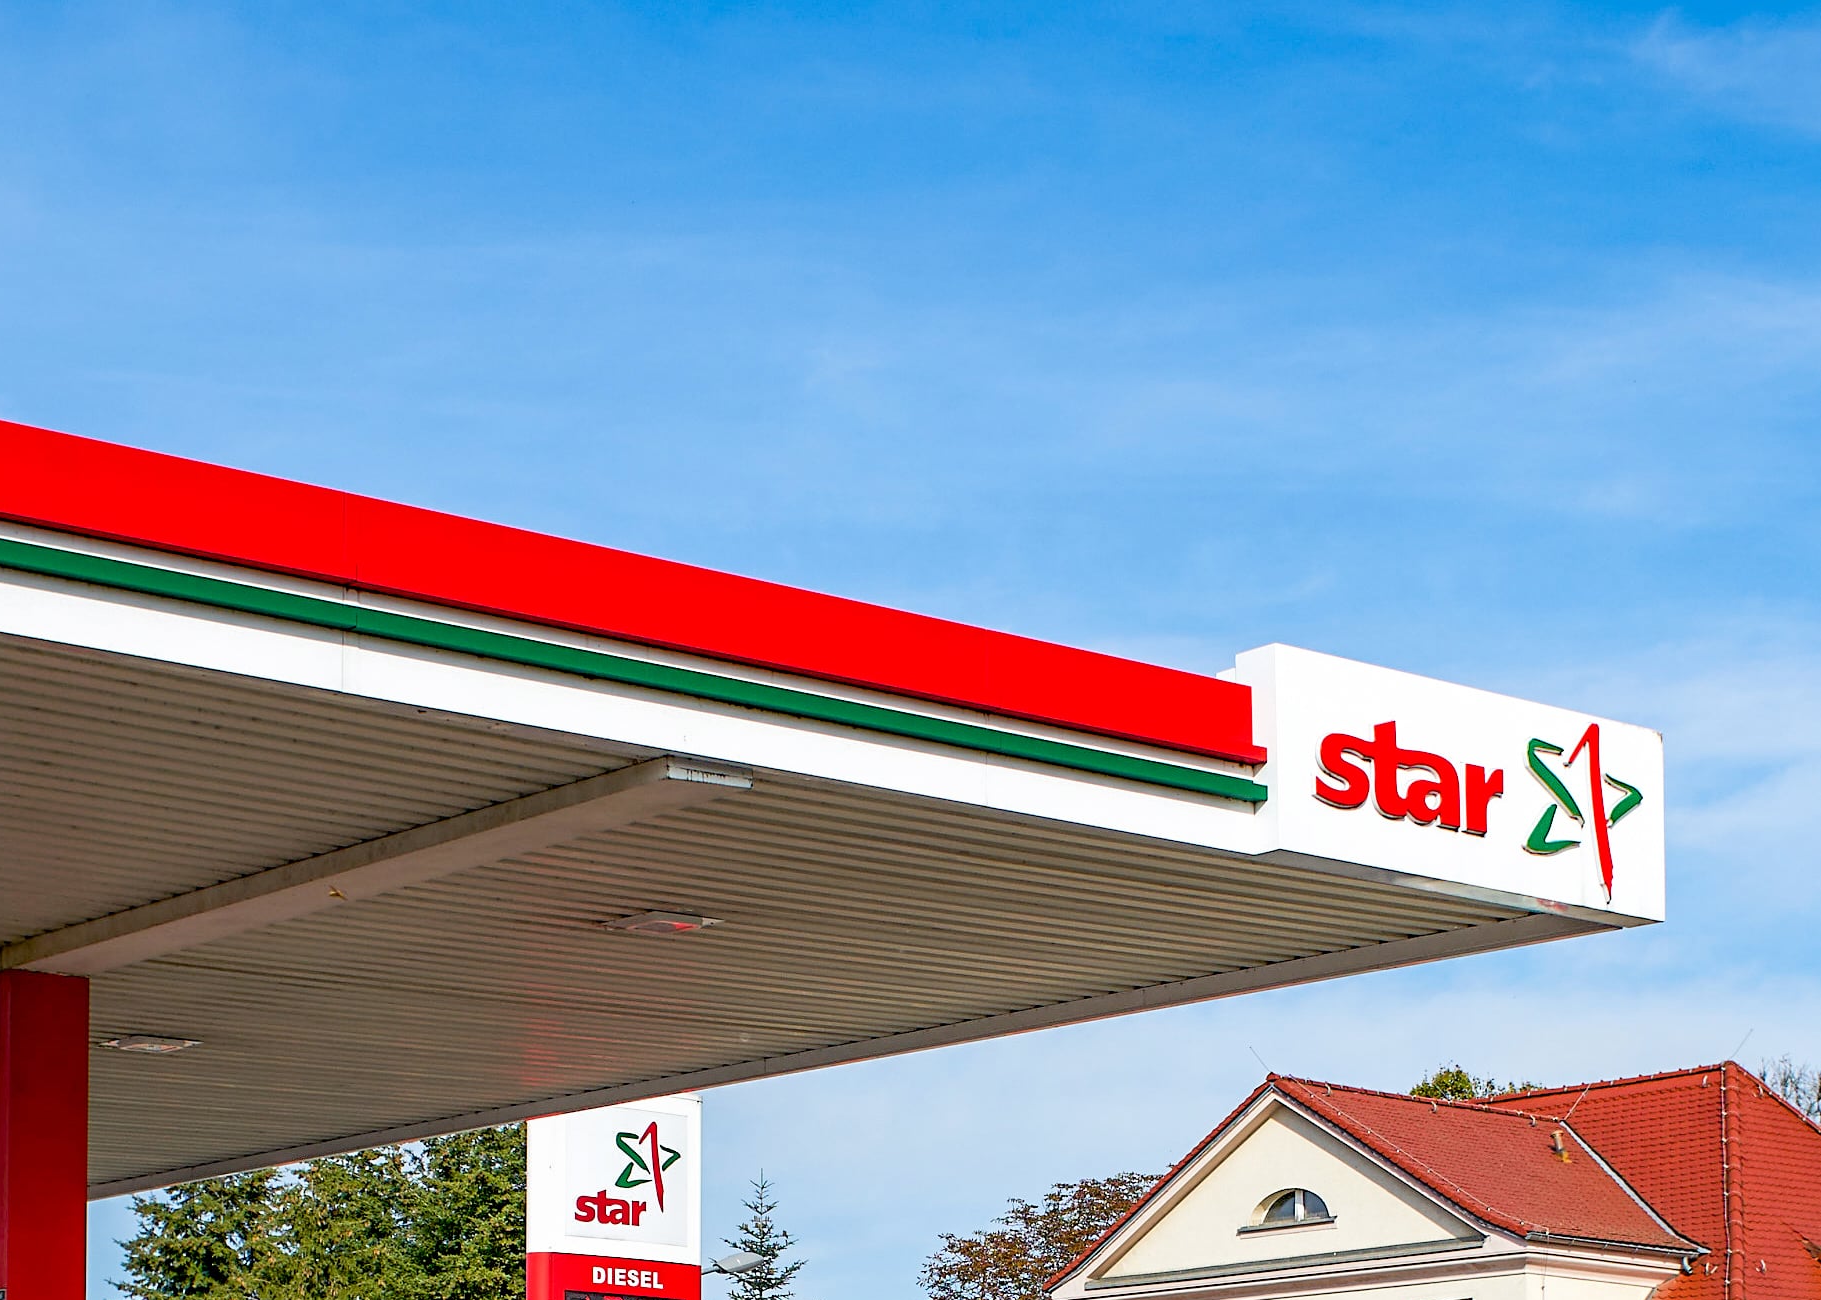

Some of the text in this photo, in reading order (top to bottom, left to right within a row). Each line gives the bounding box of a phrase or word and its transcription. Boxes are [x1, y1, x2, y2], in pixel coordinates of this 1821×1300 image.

[1312, 721, 1504, 838] star
[574, 1189, 647, 1227] star
[592, 1266, 664, 1290] DIESEL
